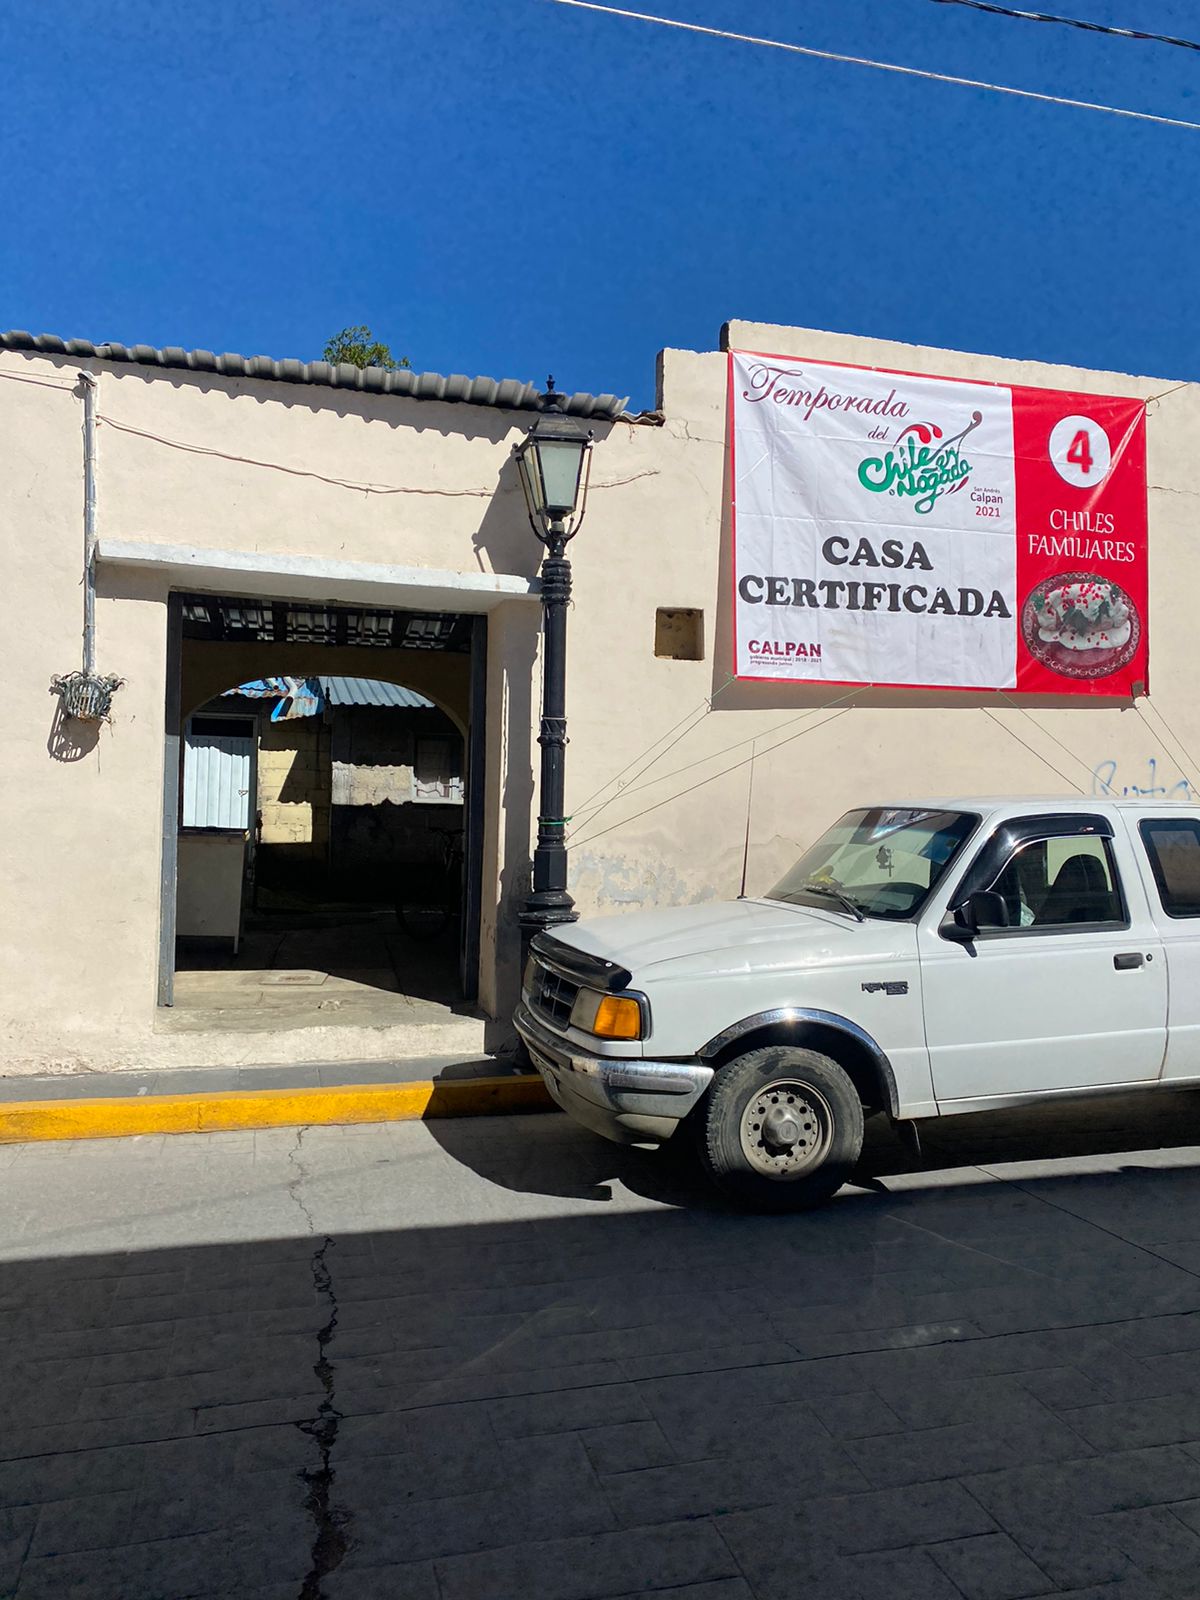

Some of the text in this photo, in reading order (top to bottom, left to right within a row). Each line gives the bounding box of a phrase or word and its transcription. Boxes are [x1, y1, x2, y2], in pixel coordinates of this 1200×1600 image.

[743, 363, 909, 420] Temporada
[867, 425, 889, 440] del
[858, 436, 931, 493] Chile
[1066, 430, 1093, 474] 4
[970, 491, 1003, 504] Calpan
[975, 505, 1000, 517] 2021
[1050, 509, 1115, 534] CHILES
[822, 536, 934, 570] CASA
[1028, 534, 1135, 563] FAMILIARES
[738, 575, 1012, 618] CERTIFICADA
[748, 639, 822, 657] CALPAN
